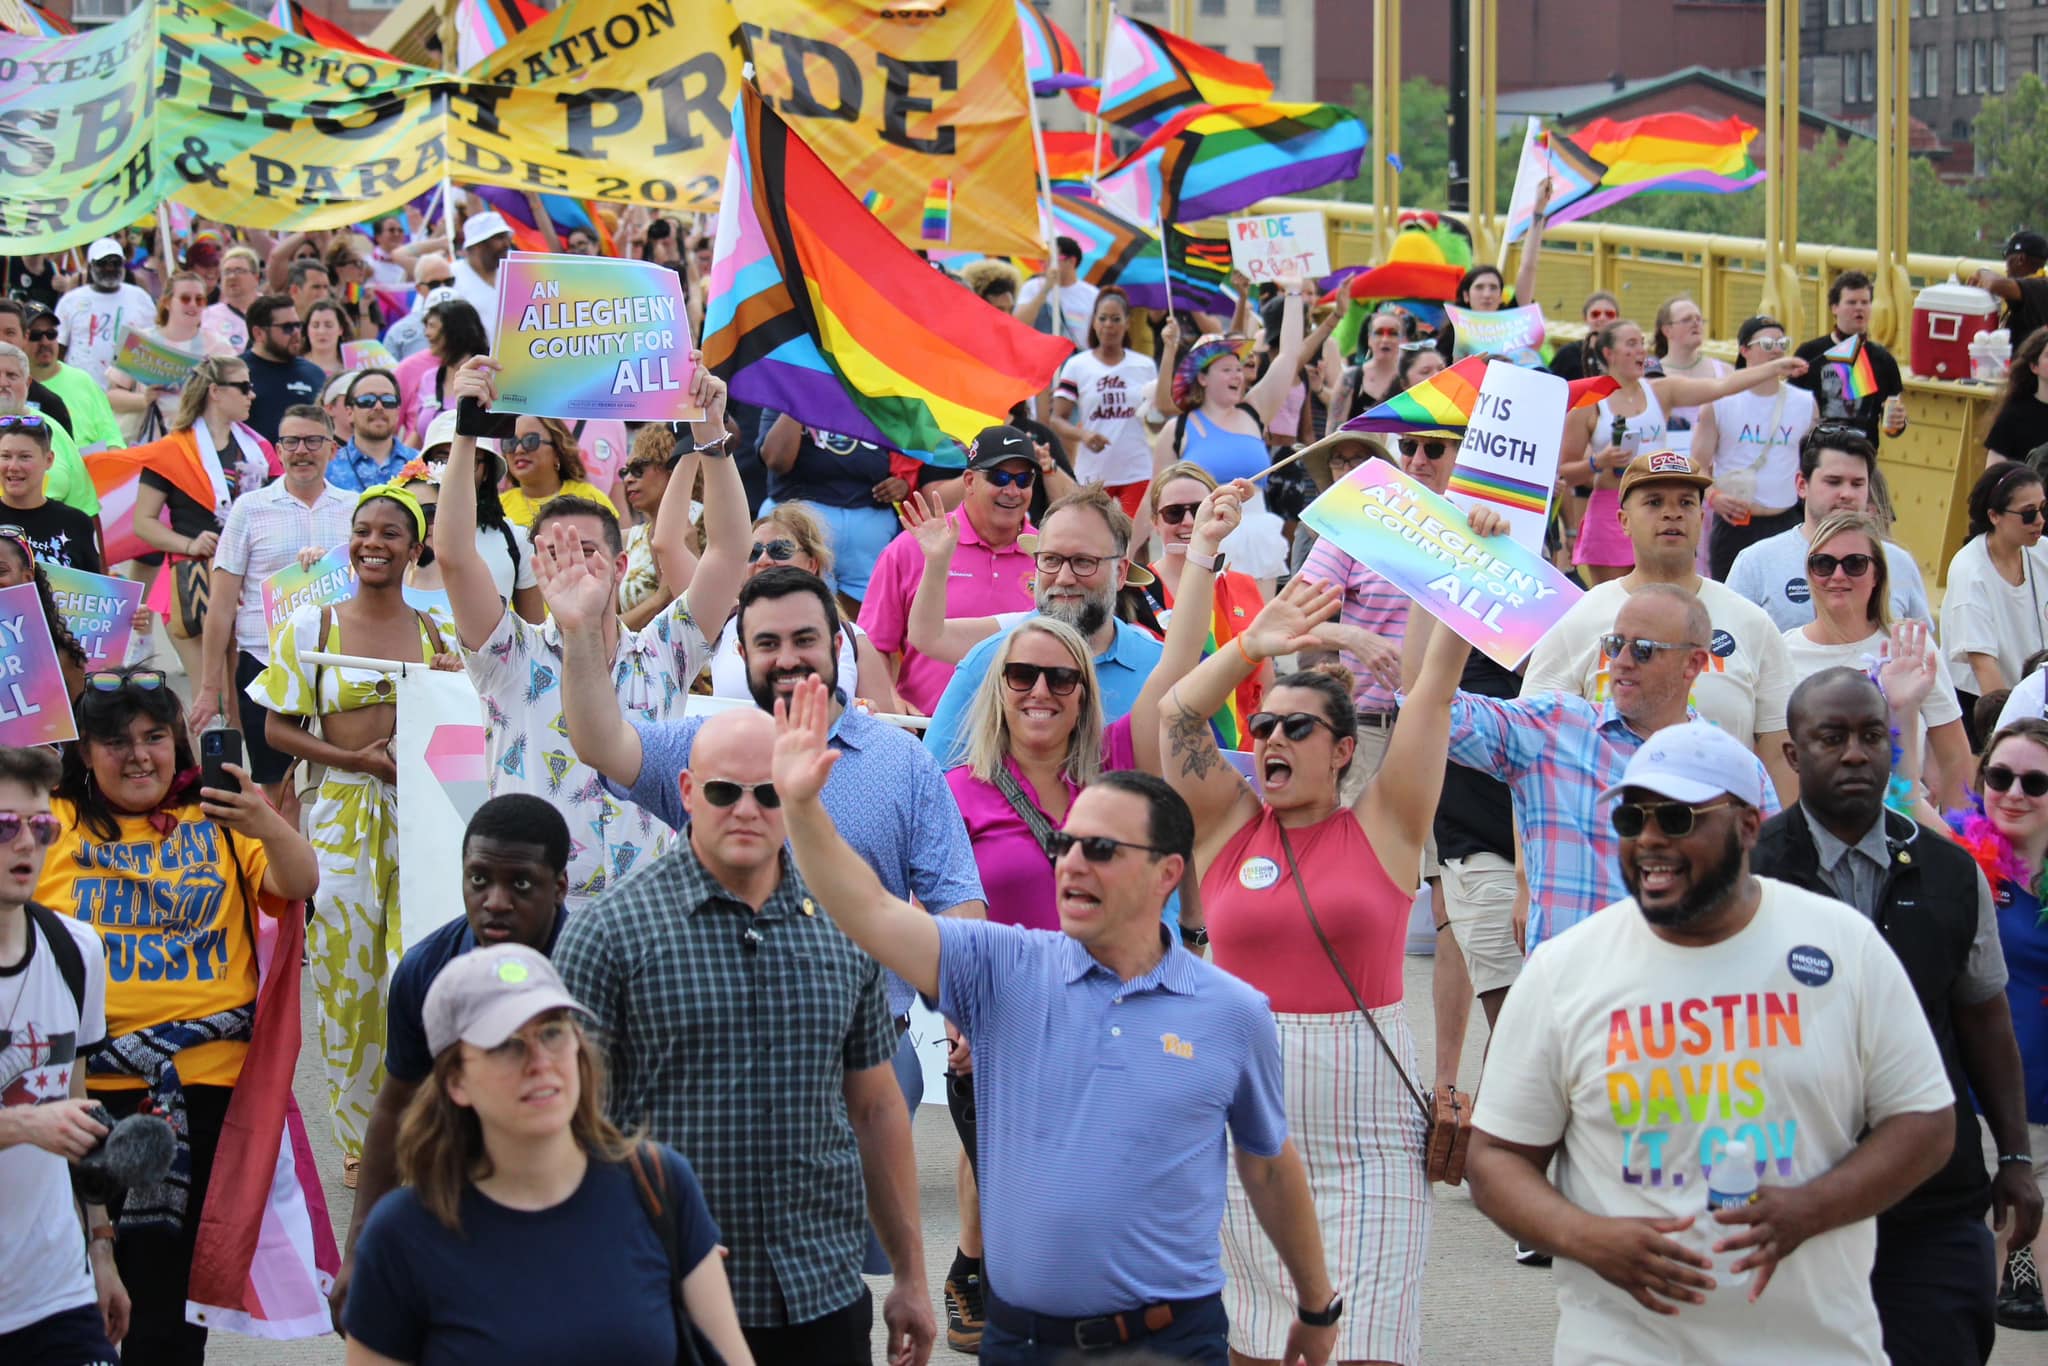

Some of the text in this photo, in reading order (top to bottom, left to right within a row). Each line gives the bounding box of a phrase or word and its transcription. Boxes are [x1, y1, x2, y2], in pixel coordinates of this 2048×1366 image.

[174, 136, 230, 189] &
[595, 175, 721, 205] 202
[1237, 216, 1295, 241] PRIDE
[519, 297, 677, 333] ALLEGHENY
[531, 280, 560, 300] AN
[529, 329, 674, 360] COUNTY FOR
[611, 356, 681, 395] ALL
[1492, 396, 1513, 421] IS
[1384, 480, 1421, 503] AN
[1360, 484, 1558, 600] ALLEGHENY
[1361, 503, 1526, 609] COUNTY FOR
[79, 617, 112, 633] FOR
[1426, 572, 1504, 634] ALL
[72, 820, 219, 876] JUST EAT
[72, 877, 176, 928] THIS
[103, 926, 228, 982] USSY!
[1792, 952, 1829, 969] PROUD
[1606, 992, 1803, 1067] AUSTIN
[1606, 1059, 1766, 1127] DAVIS
[1621, 1130, 1684, 1187] LT.
